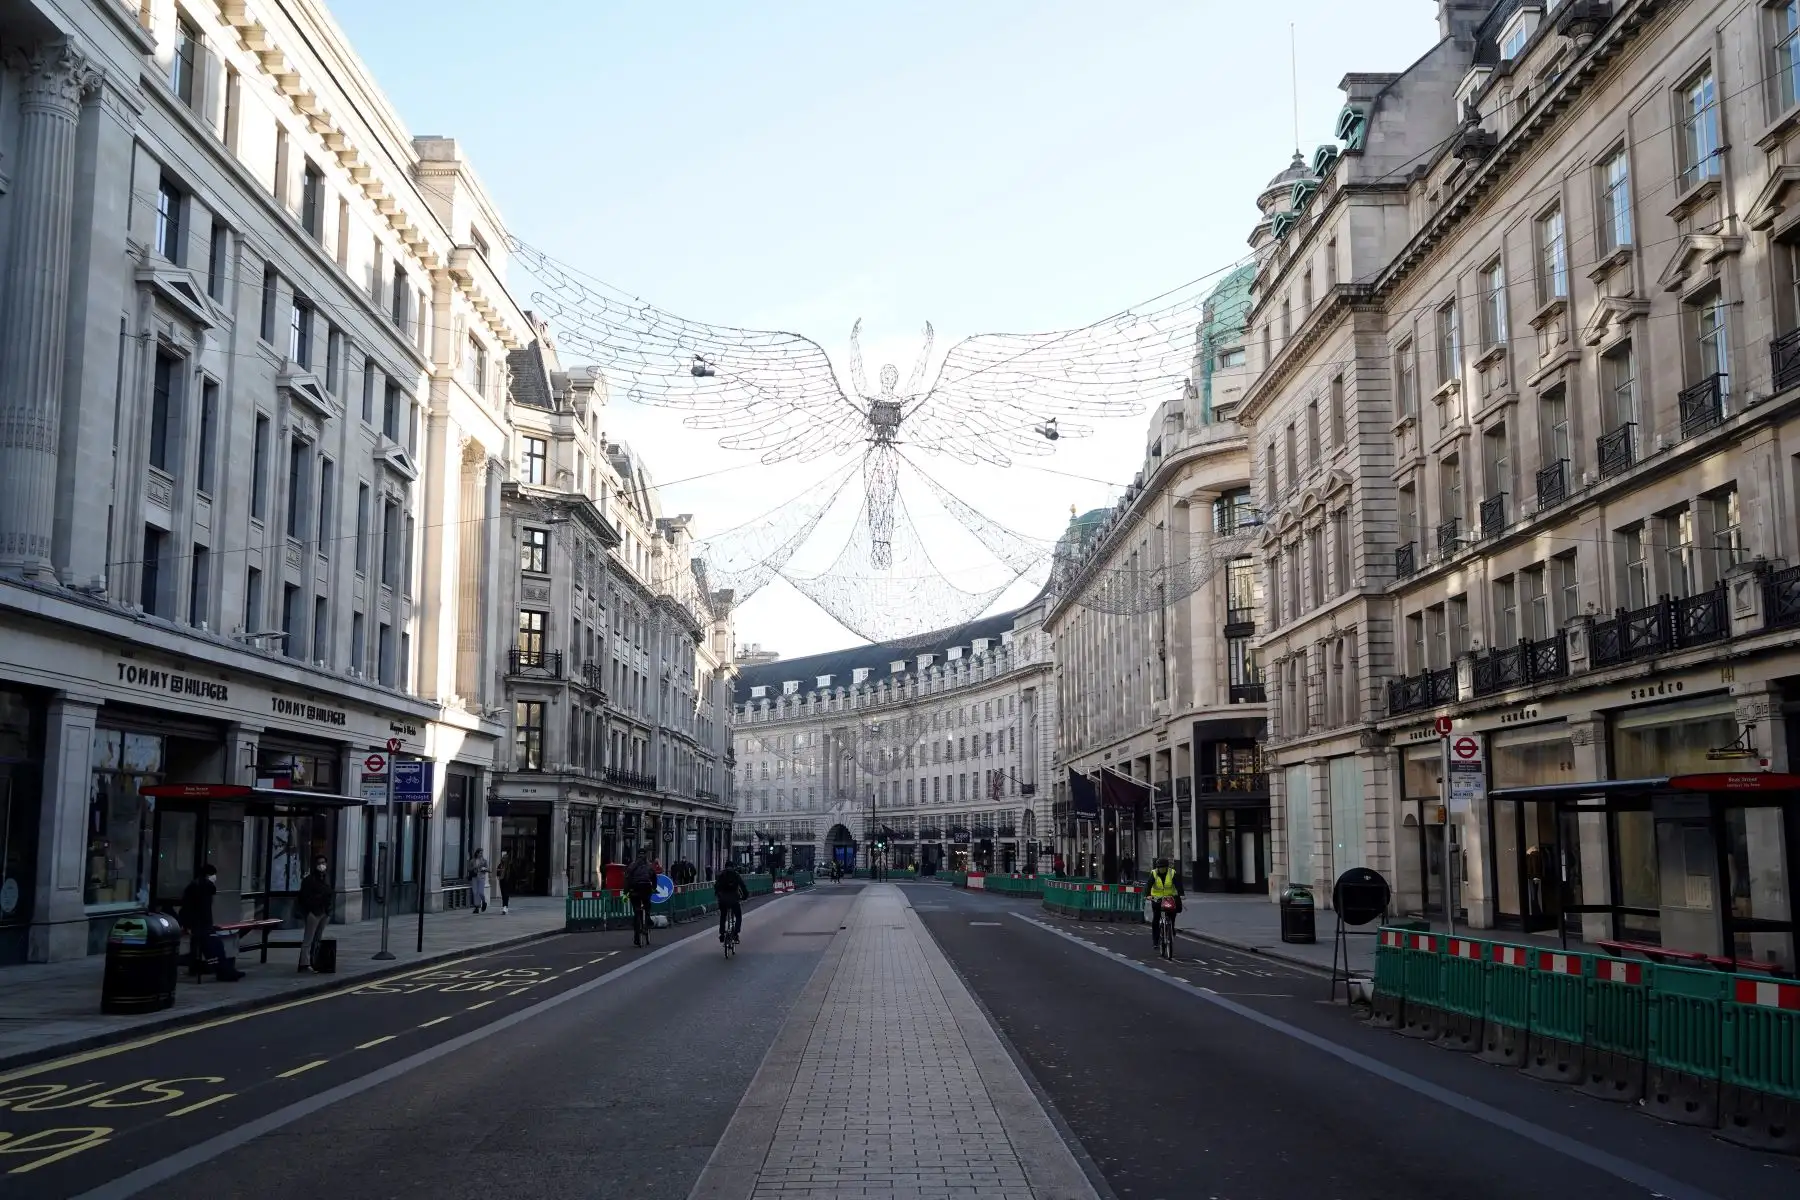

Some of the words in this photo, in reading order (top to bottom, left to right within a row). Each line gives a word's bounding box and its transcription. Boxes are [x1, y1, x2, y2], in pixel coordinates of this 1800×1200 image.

[117, 662, 169, 689] TOMMY
[185, 677, 228, 701] HILFIGER
[1631, 680, 1684, 700] sandro
[272, 697, 306, 718] TOMMY
[316, 707, 346, 726] HILFIGER
[1501, 708, 1538, 723] sandro
[1440, 719, 1449, 732] L
[1410, 727, 1437, 740] sandro
[411, 967, 552, 980] BUS
[352, 980, 538, 995] STOP
